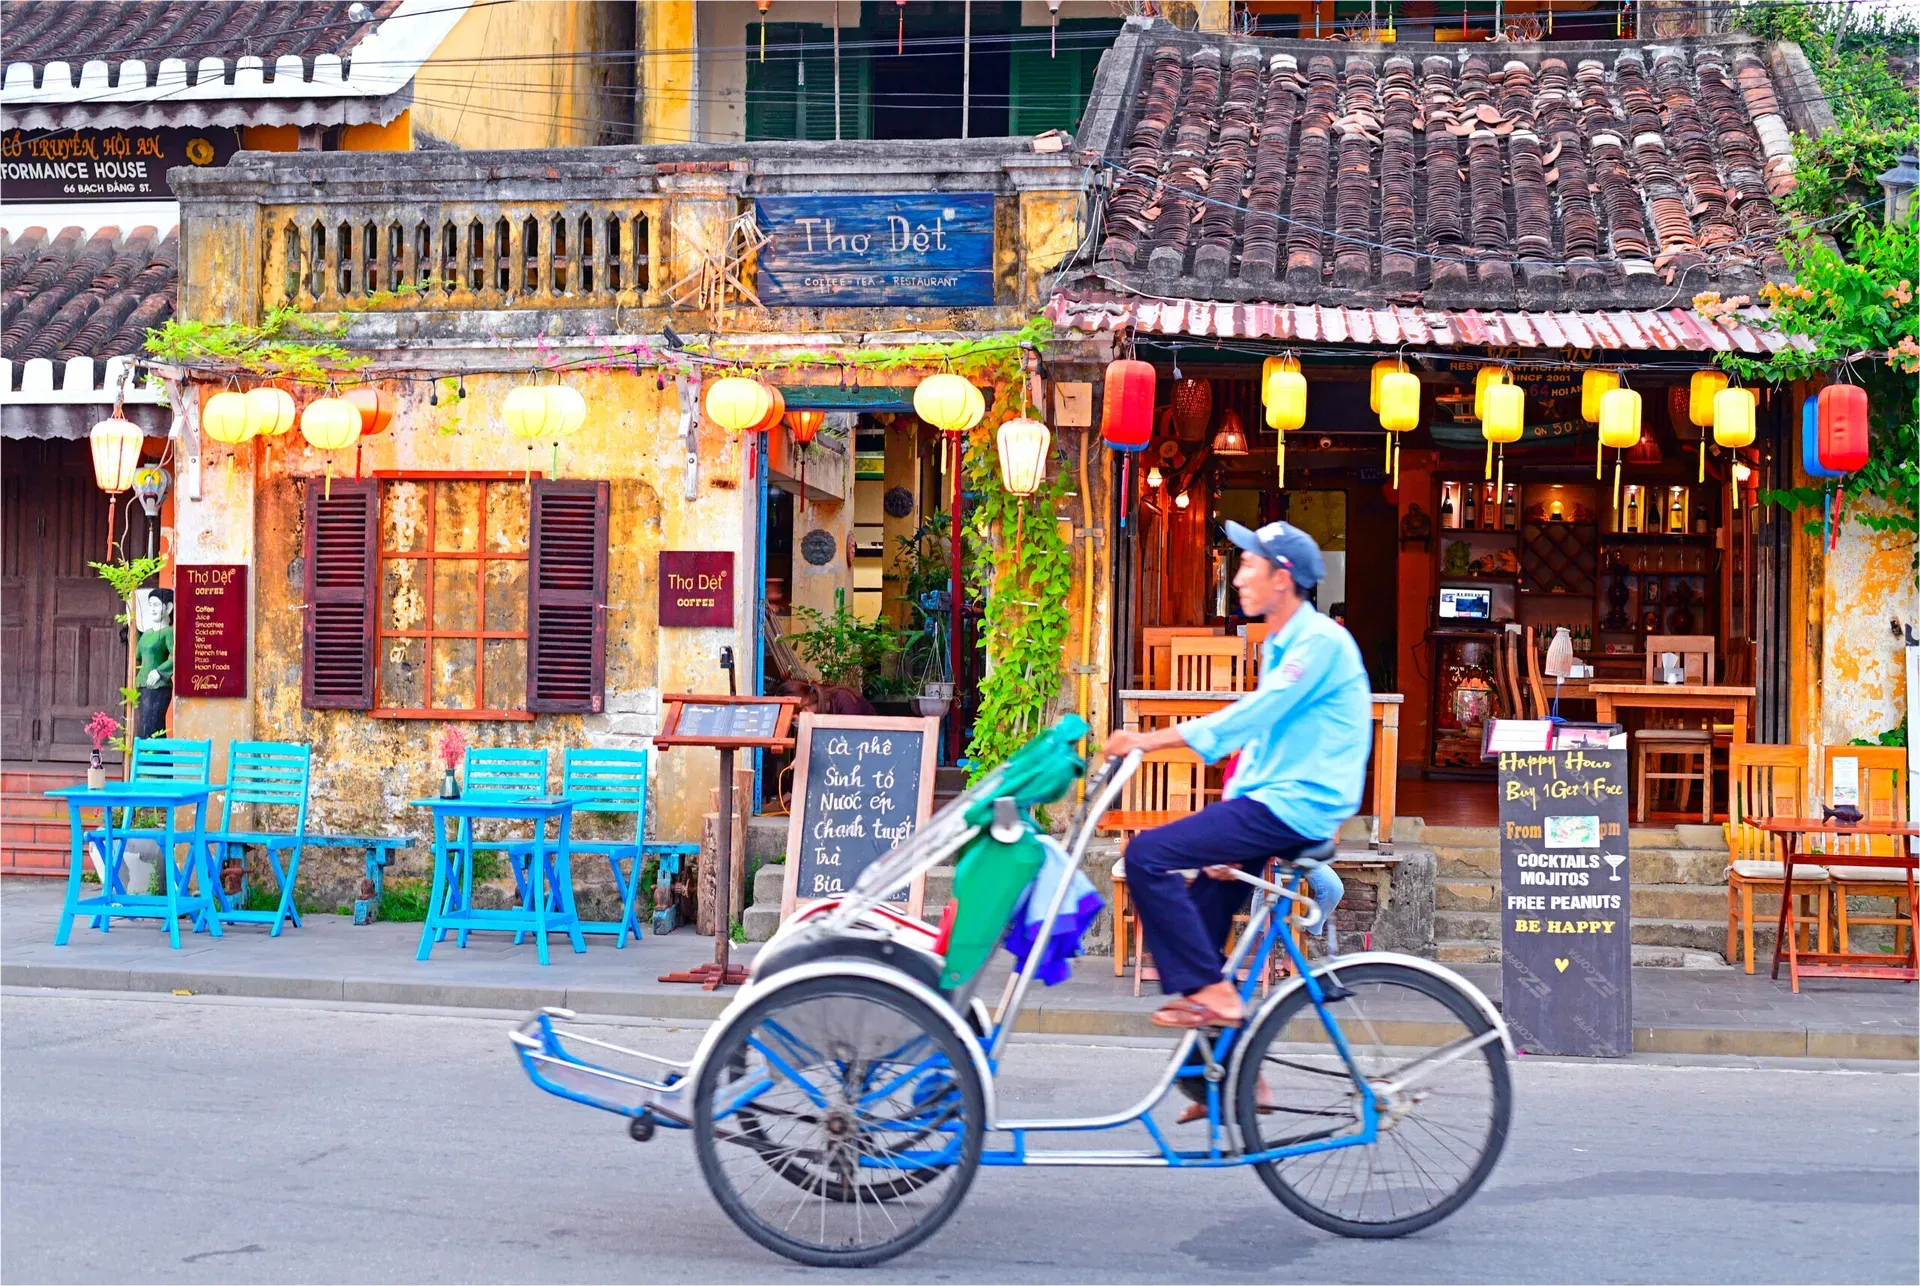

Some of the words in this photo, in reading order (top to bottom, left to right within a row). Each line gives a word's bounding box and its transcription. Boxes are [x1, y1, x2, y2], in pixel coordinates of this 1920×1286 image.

[103, 132, 131, 160] HỘI
[136, 135, 164, 158] AN
[0, 162, 89, 180] FORMANCE
[95, 162, 147, 178] HOUSE
[64, 185, 75, 193] 66
[78, 184, 104, 194] BẠCH
[139, 184, 151, 192] ST.
[795, 218, 871, 256] Thợ
[887, 215, 947, 255] Dệt
[856, 278, 875, 286] TEA
[893, 277, 957, 287] RESTAURANT
[1546, 374, 1571, 382] 2001
[1551, 387, 1569, 397] HOI
[195, 587, 224, 595] COFFEE
[668, 574, 694, 592] Thợ
[195, 605, 214, 613] Coffee
[677, 599, 715, 607] COFFEE
[195, 621, 224, 629] Smoothies
[855, 735, 893, 760] phê
[1499, 751, 1558, 780] Happy
[1565, 750, 1612, 771] Hour
[824, 764, 865, 788] Sinh
[820, 791, 862, 811] Nước
[1505, 780, 1537, 811] Buy
[1593, 777, 1623, 798] Free
[814, 815, 866, 839] Chanh
[1506, 820, 1542, 840] From
[814, 845, 842, 866] Trà
[1517, 853, 1600, 869] COCKTAILS
[813, 874, 844, 892] Bia
[1520, 871, 1590, 887] MOJITOS
[1507, 896, 1546, 910] FREE
[1550, 895, 1622, 910] PEANUTS
[1515, 919, 1541, 933] BE
[1547, 921, 1616, 934] HAPPY
